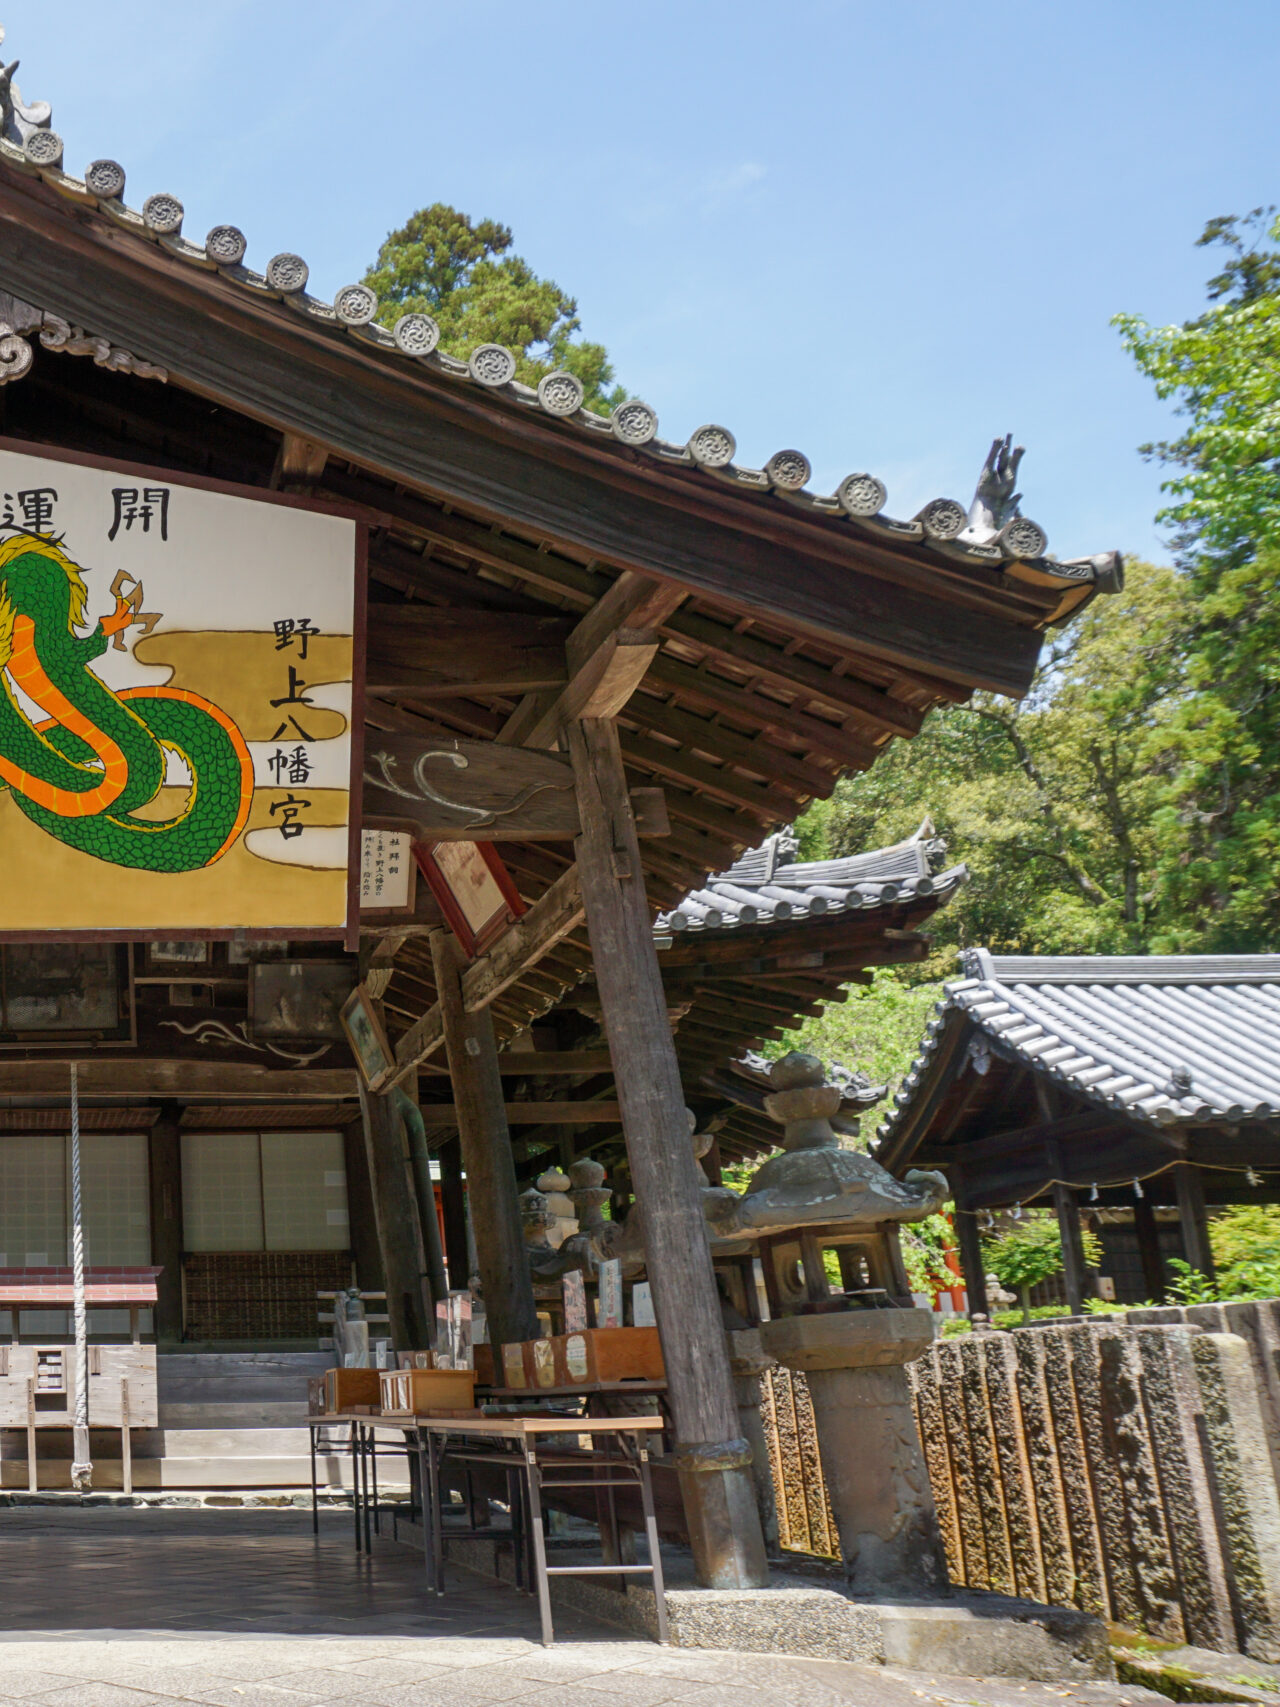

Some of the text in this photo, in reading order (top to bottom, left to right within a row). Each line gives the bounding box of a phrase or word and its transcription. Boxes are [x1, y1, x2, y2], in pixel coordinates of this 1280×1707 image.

[267, 618, 320, 841] 野上八幡宮
